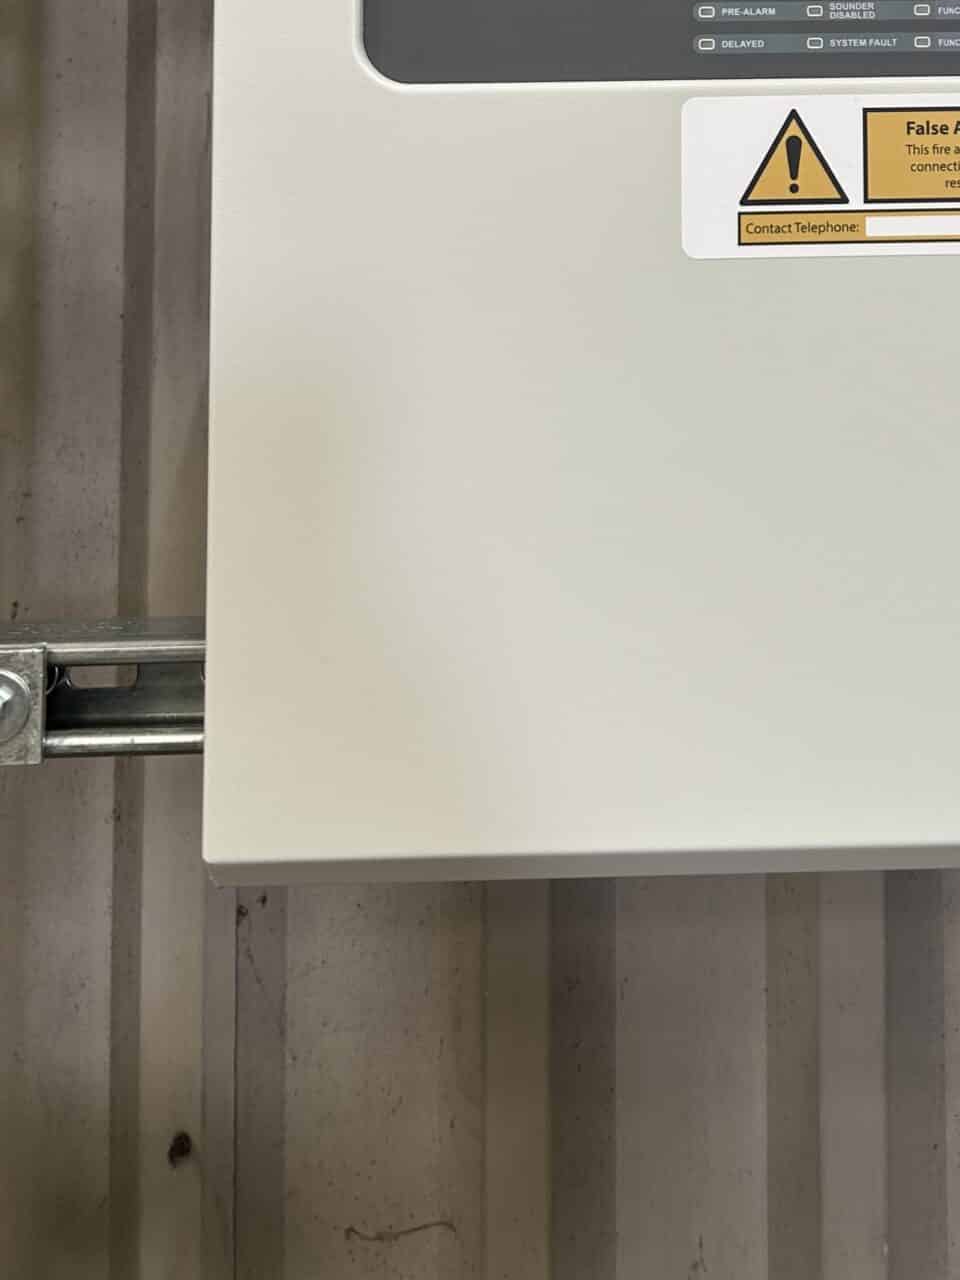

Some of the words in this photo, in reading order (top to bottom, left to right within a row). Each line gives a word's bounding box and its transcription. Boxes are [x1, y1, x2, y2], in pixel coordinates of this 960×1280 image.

[721, 7, 776, 16] PRE-ALARM
[828, 2, 876, 11] SOUNDER
[829, 10, 876, 20] DISABLED
[721, 39, 765, 49] DELAYED
[829, 38, 867, 48] SYSTEM
[867, 38, 897, 47] FAULT
[906, 119, 950, 136] False
[905, 143, 929, 156] This
[931, 143, 952, 155] fire
[745, 222, 793, 235] Contact
[794, 220, 861, 236] Telephone:
